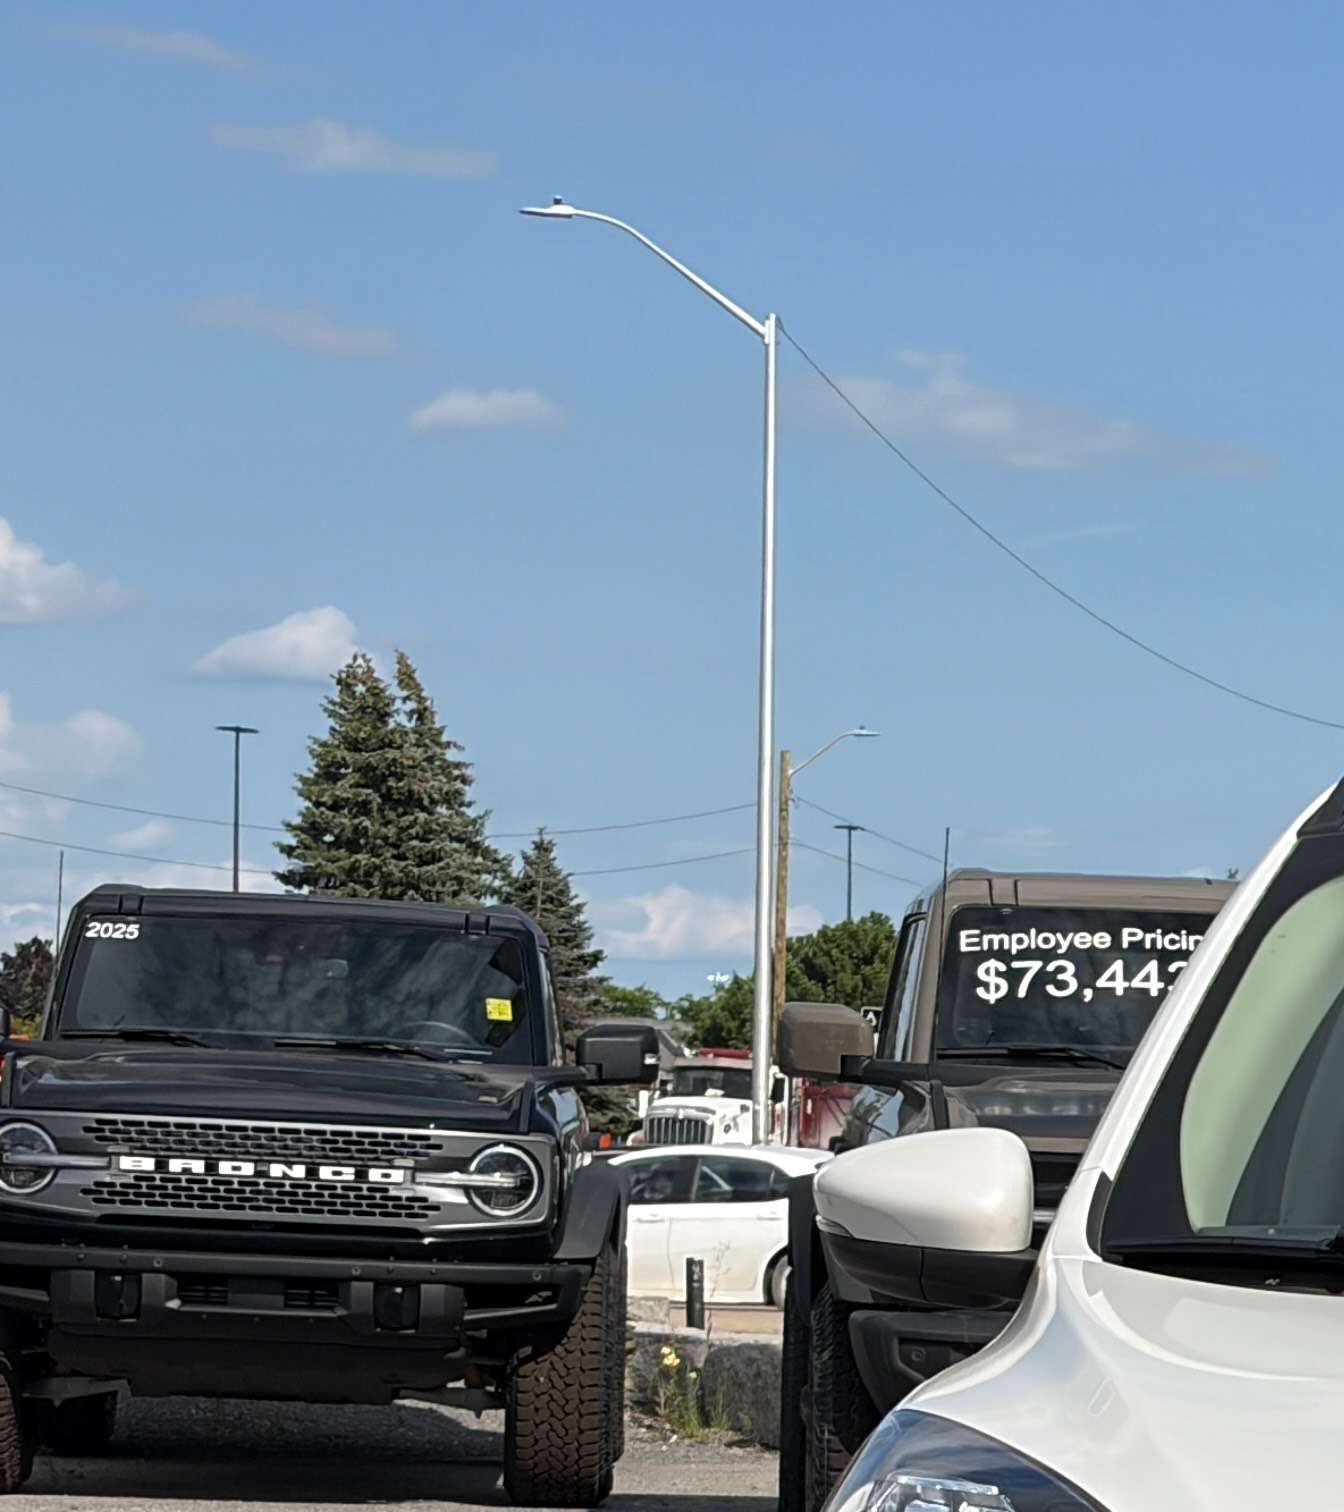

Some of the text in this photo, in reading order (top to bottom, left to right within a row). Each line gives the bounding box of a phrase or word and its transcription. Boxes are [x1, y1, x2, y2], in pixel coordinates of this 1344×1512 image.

[85, 921, 141, 939] 2025
[959, 928, 1112, 955] Employee
[118, 1155, 405, 1183] BRONCO
